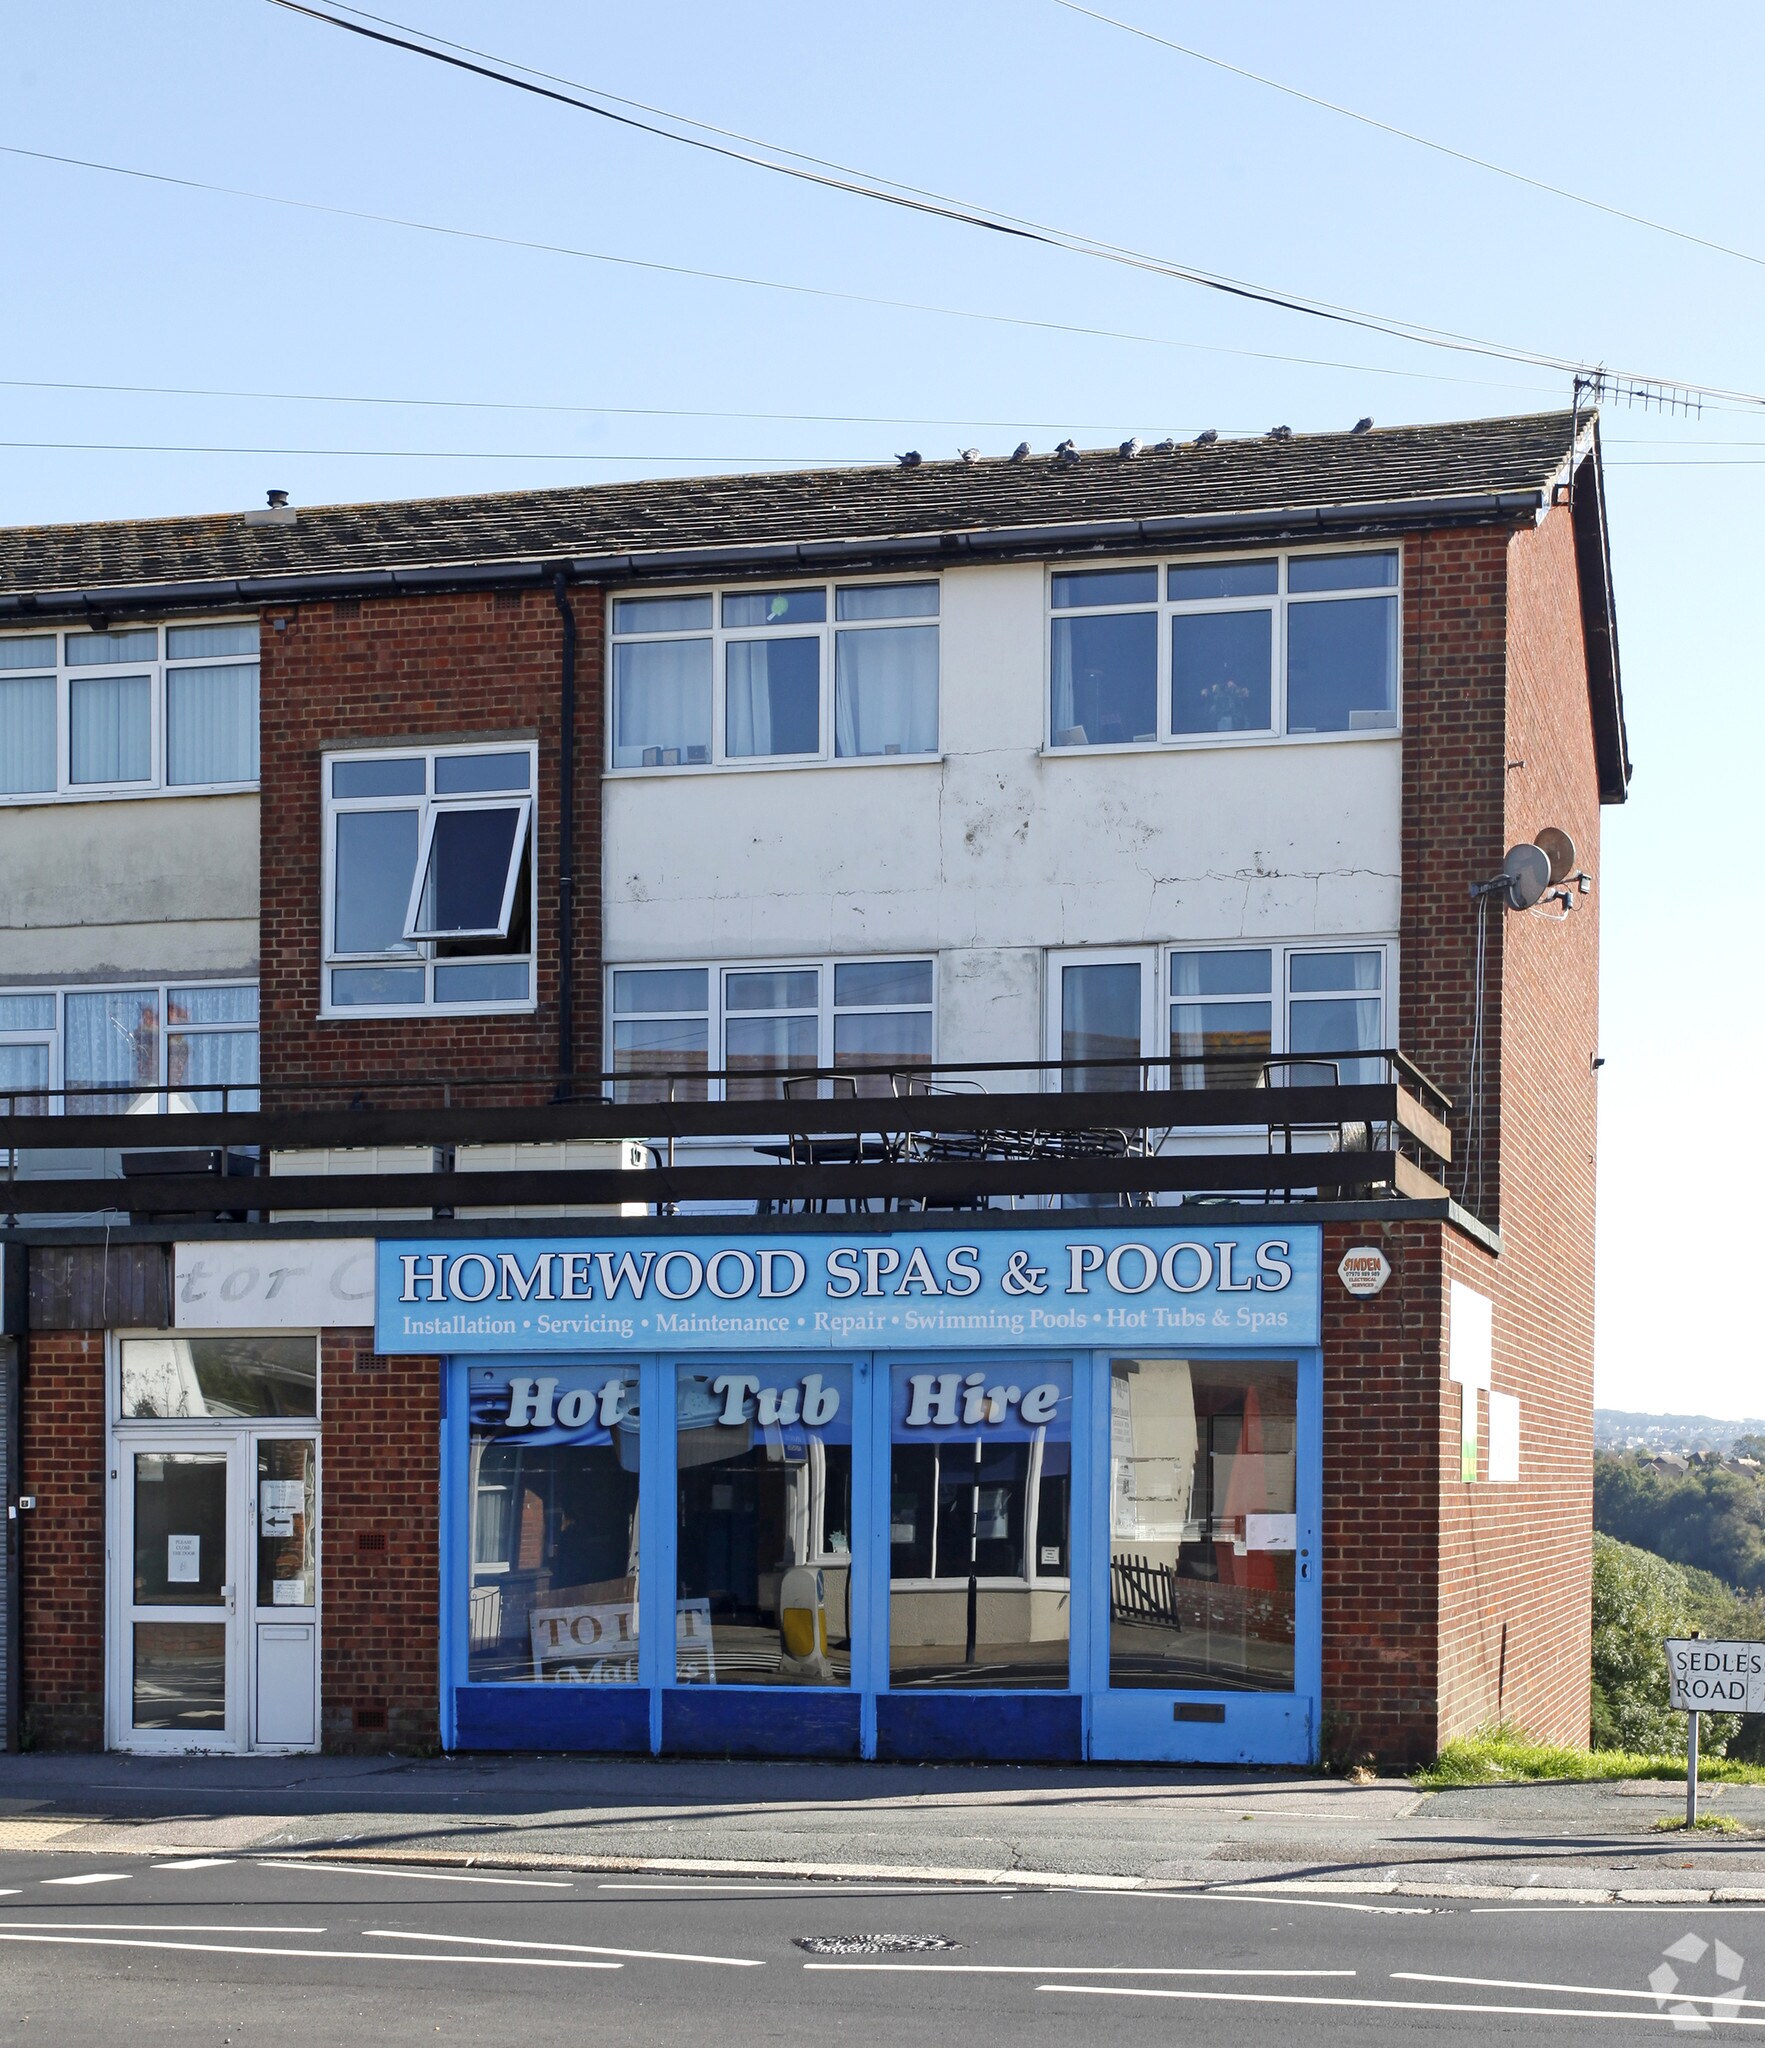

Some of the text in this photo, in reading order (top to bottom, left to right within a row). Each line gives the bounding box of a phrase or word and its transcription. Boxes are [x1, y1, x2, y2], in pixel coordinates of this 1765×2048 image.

[399, 1240, 1293, 1302] HOMEWOOD SPAS & POOLS
[1343, 1257, 1381, 1271] SINDEN
[403, 1307, 1288, 1338] Installation Servicing Maintenance Repair Swimming Pools Hot Tubs & Spas
[504, 1376, 626, 1429] Hot
[713, 1373, 840, 1427] Tub
[905, 1372, 1060, 1426] Hire
[539, 1608, 703, 1647] TO LT
[1677, 1651, 1765, 1674] SEDLES
[1677, 1679, 1745, 1700] ROAD
